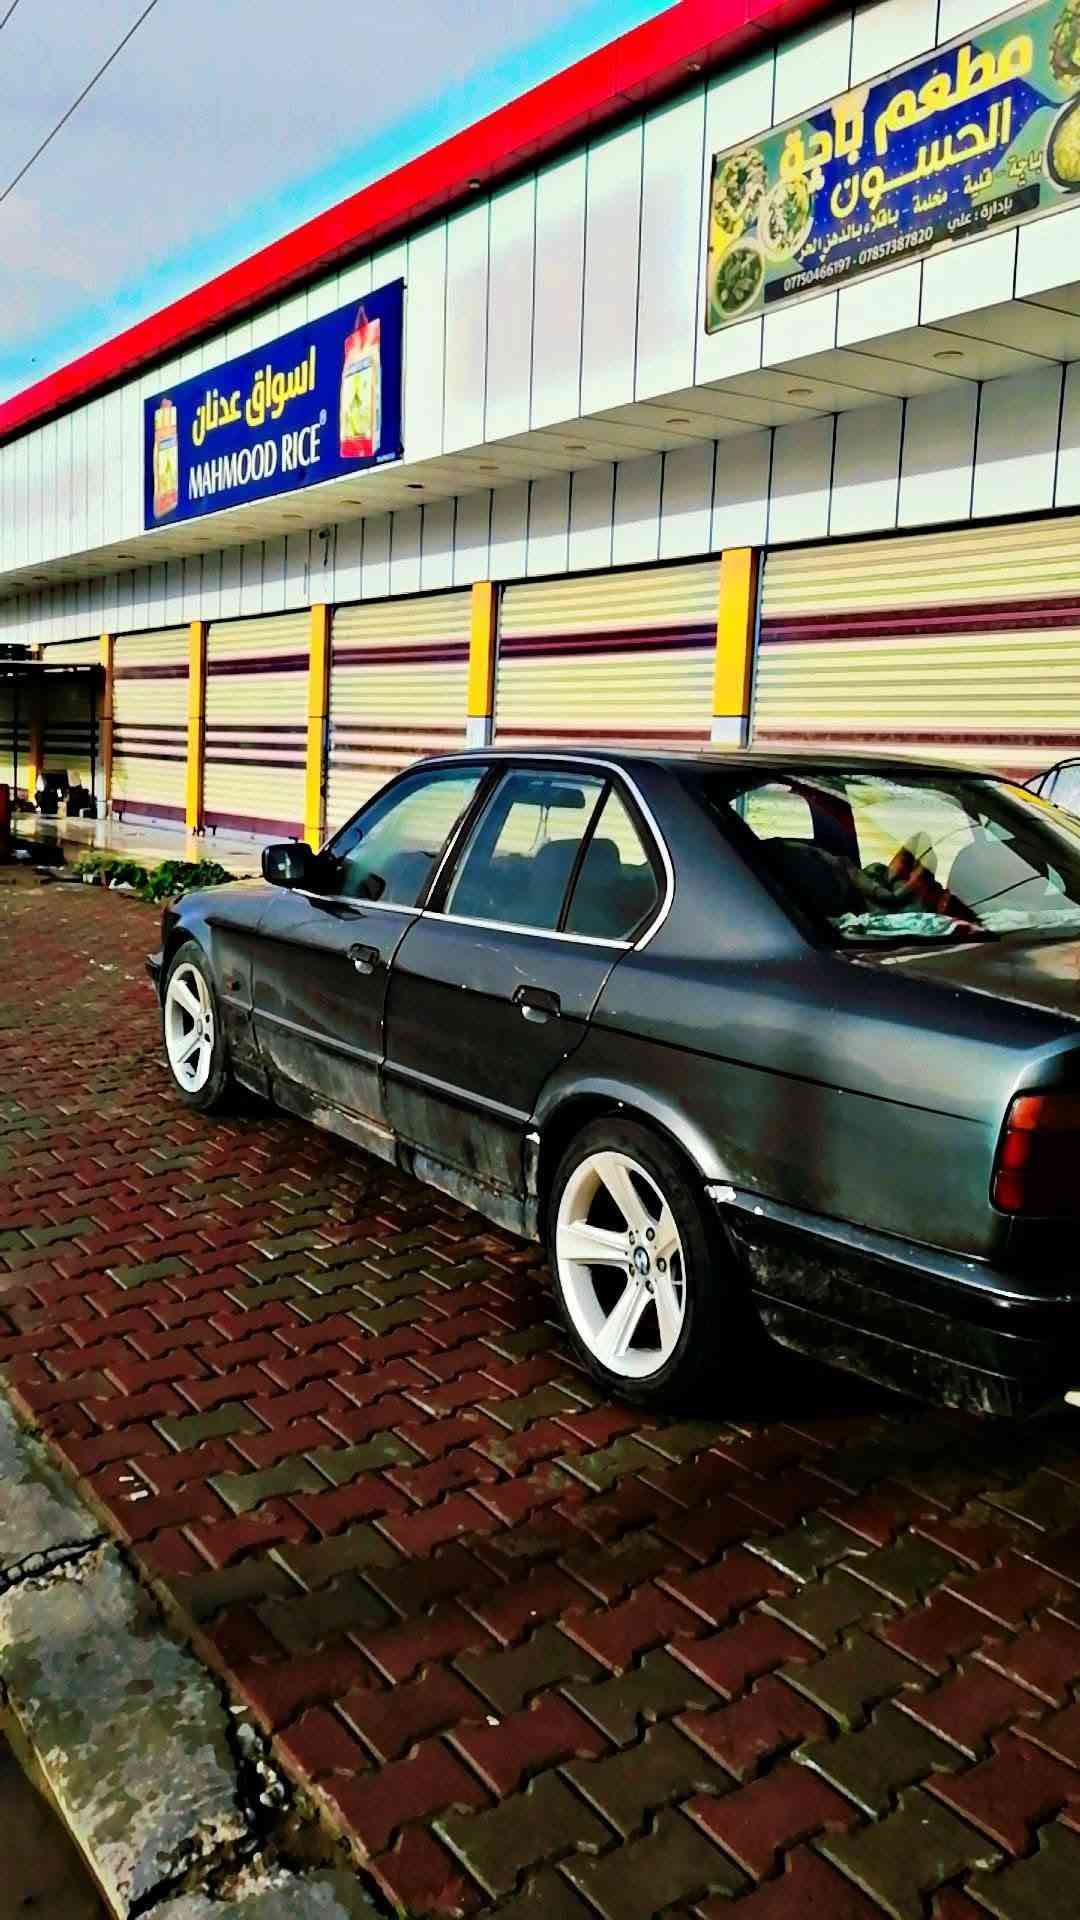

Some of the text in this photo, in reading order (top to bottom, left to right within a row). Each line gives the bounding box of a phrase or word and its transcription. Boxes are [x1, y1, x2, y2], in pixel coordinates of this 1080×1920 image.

[874, 35, 1034, 155] مطعم
[830, 97, 1012, 219] الحسون
[191, 345, 317, 447] اسواق عدنان
[188, 439, 276, 500] MAHMOOD
